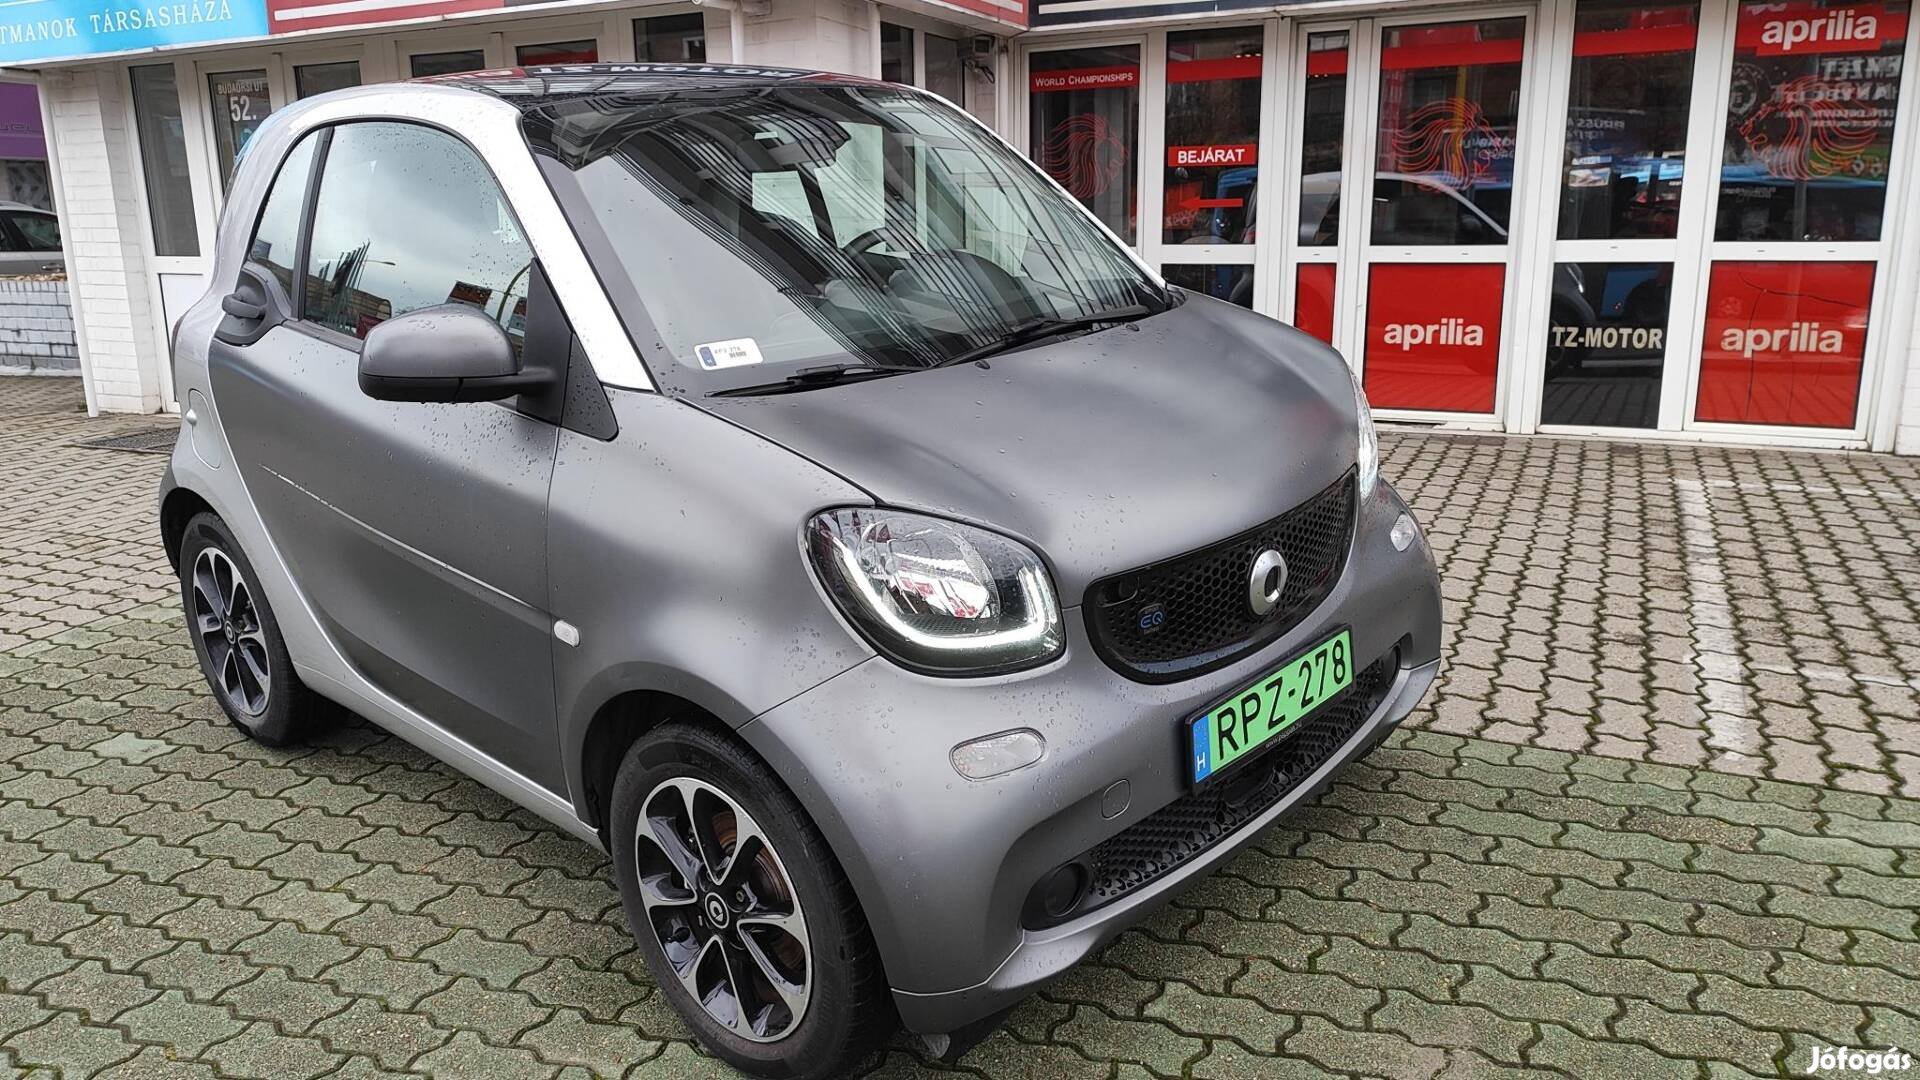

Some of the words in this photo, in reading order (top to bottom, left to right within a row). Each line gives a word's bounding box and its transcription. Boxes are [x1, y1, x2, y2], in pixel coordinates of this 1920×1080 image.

[1761, 9, 1877, 50] aprilia
[230, 95, 257, 121] 52.
[1178, 147, 1245, 163] BEJÁRAT
[1384, 318, 1484, 351] aprilia
[1552, 326, 1663, 349] TZ-MOTOR
[1720, 321, 1844, 358] aprilia
[1217, 639, 1346, 760] RPZ-278
[1196, 752, 1206, 771] H
